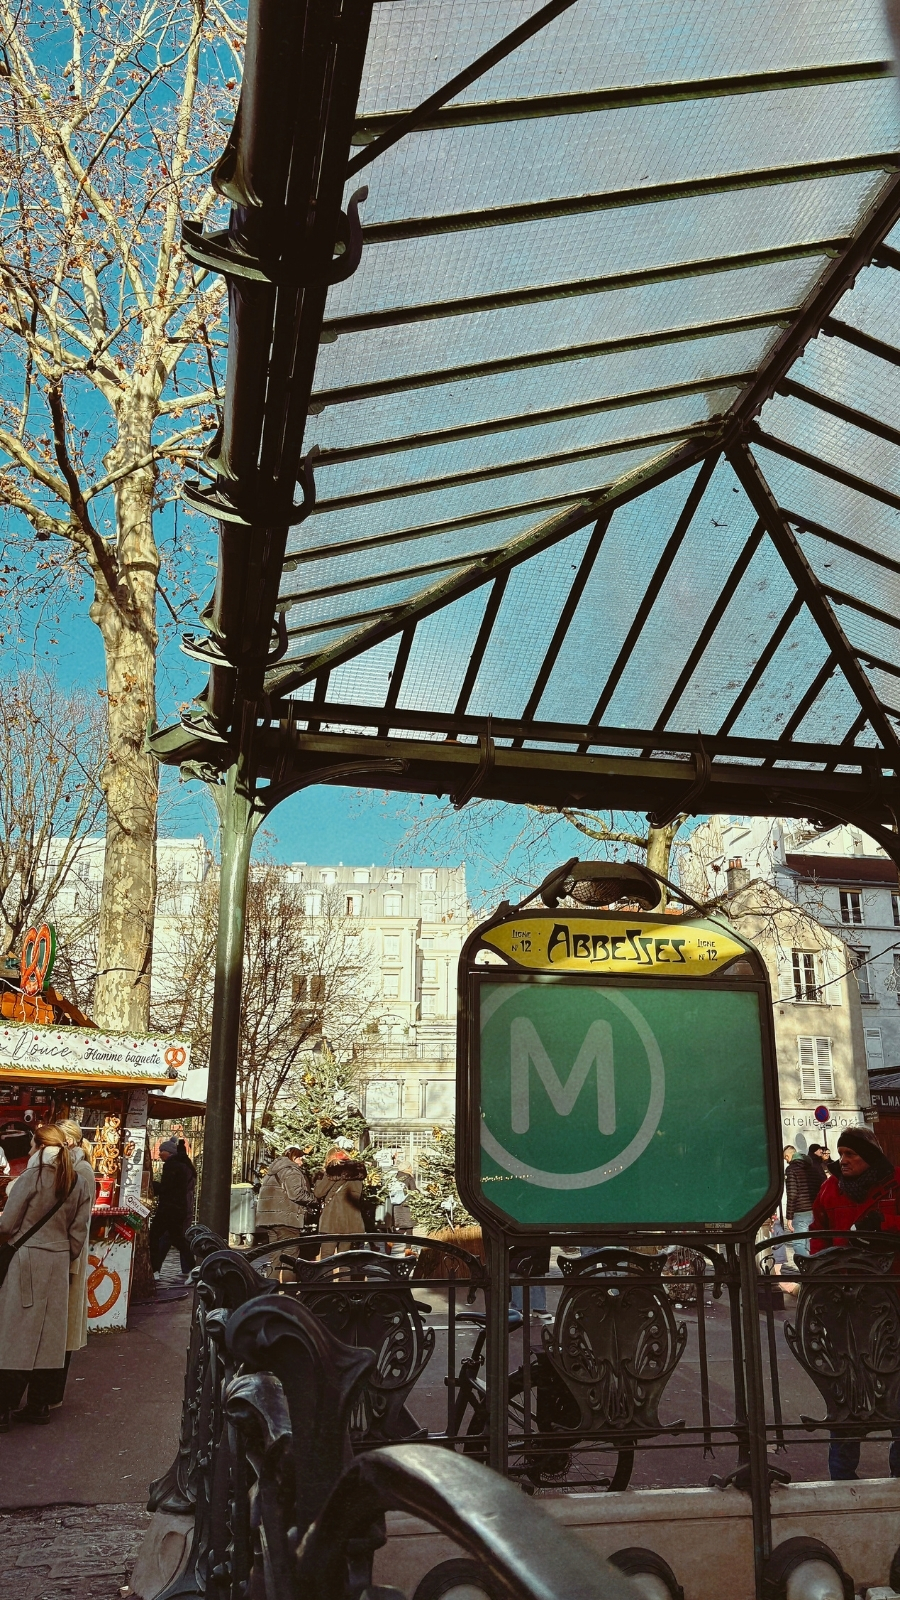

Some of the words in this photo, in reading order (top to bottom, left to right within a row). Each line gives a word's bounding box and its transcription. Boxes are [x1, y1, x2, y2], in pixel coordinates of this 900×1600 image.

[519, 939, 532, 953] 12
[706, 949, 718, 962] 12
[12, 1030, 72, 1061] Douce
[83, 1047, 123, 1062] Flamme
[125, 1051, 161, 1067] baguette
[510, 1016, 616, 1136] M
[783, 1115, 820, 1127] atelie
